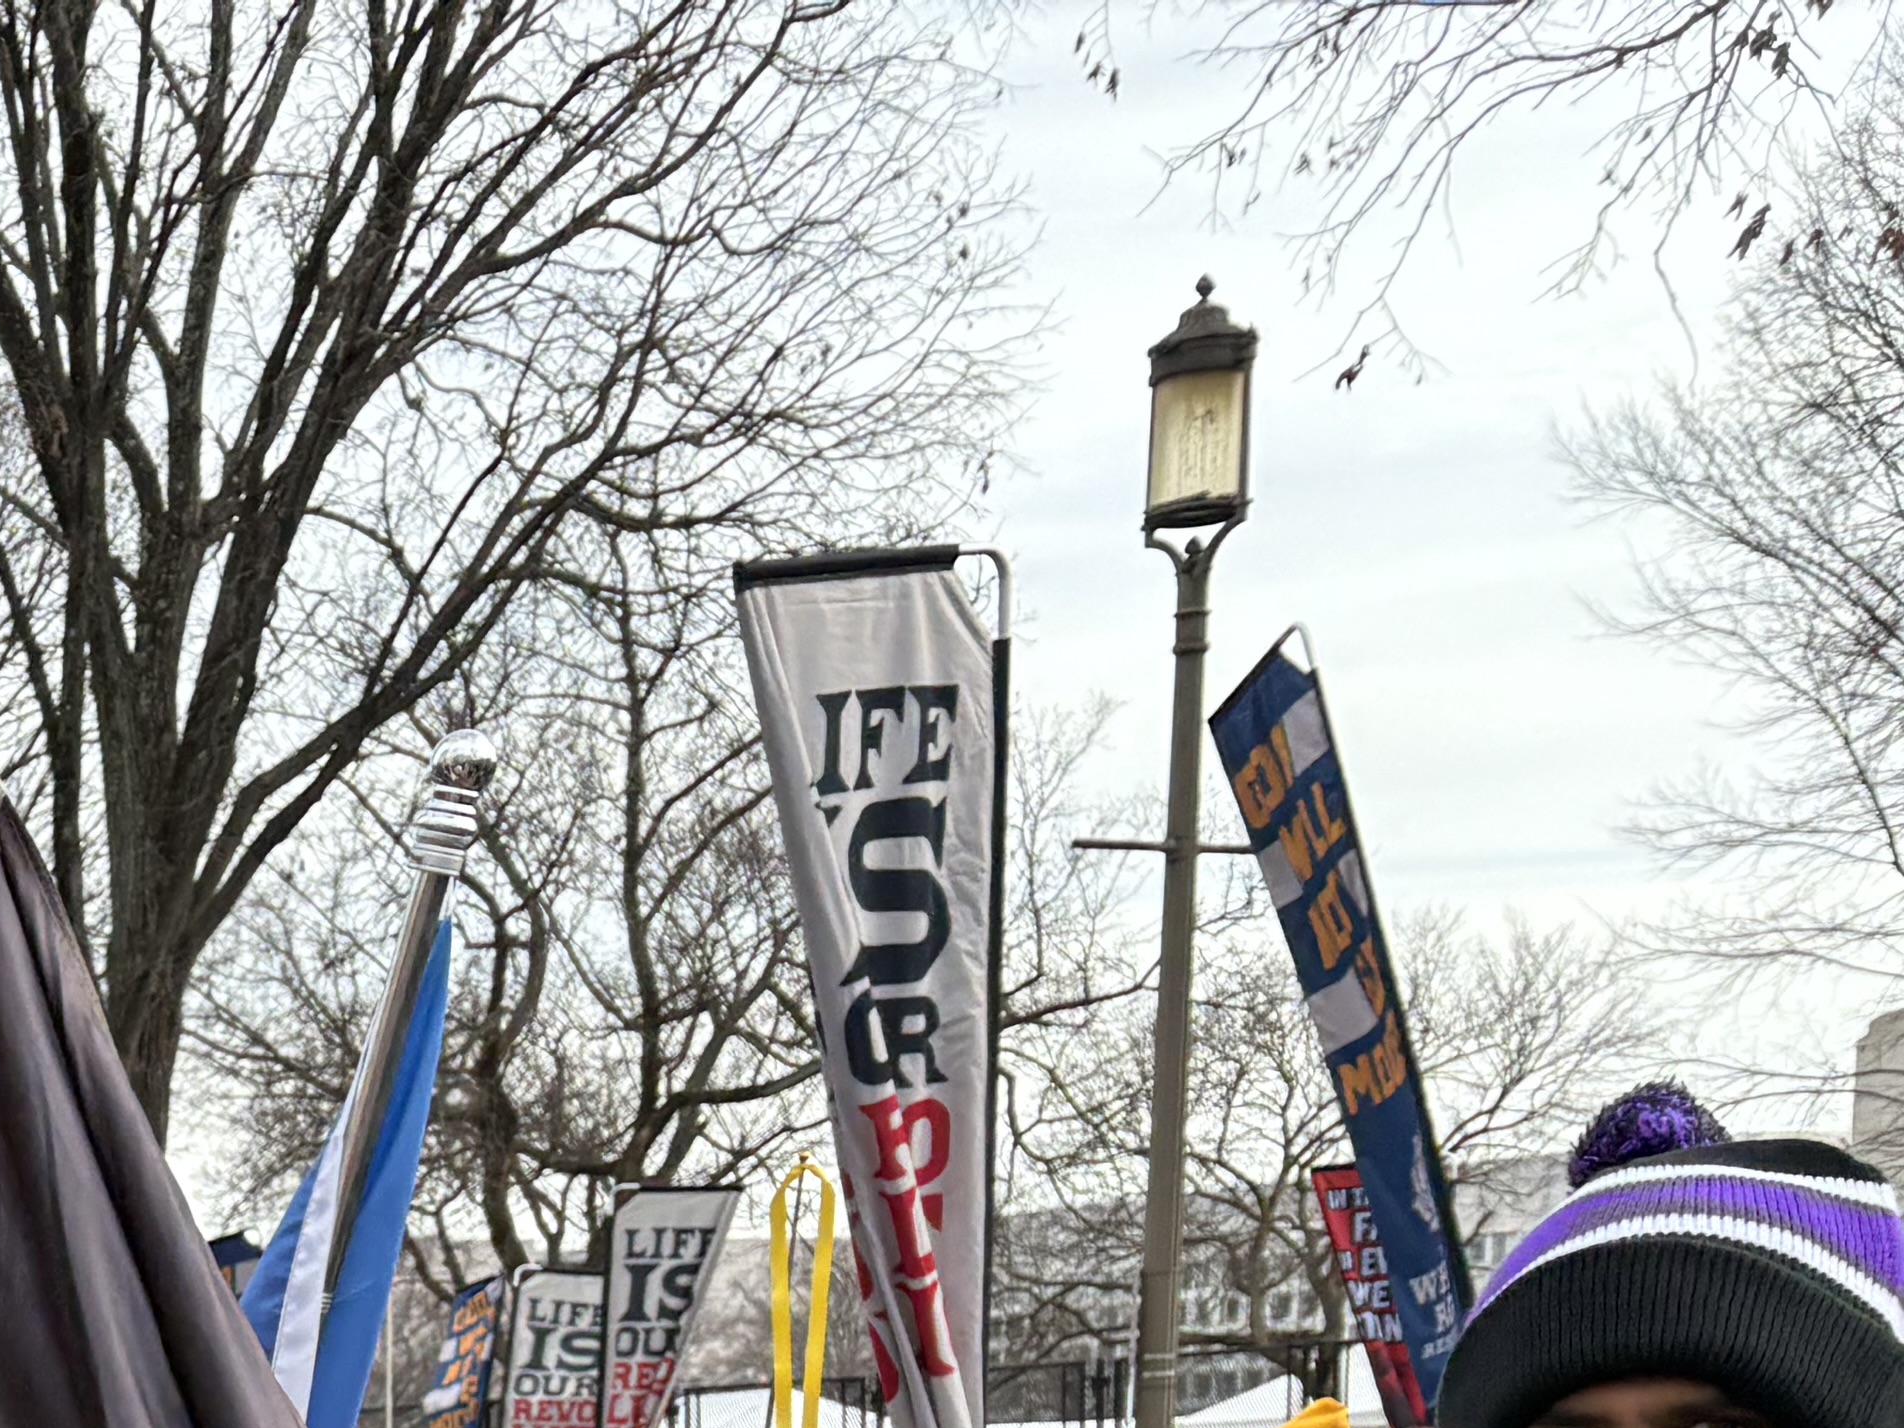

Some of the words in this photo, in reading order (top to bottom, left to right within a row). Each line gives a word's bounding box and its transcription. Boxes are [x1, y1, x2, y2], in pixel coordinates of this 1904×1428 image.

[814, 682, 959, 794] IFE
[622, 1262, 700, 1323] IS
[525, 1326, 601, 1371] IS
[513, 1372, 601, 1397] OUR
